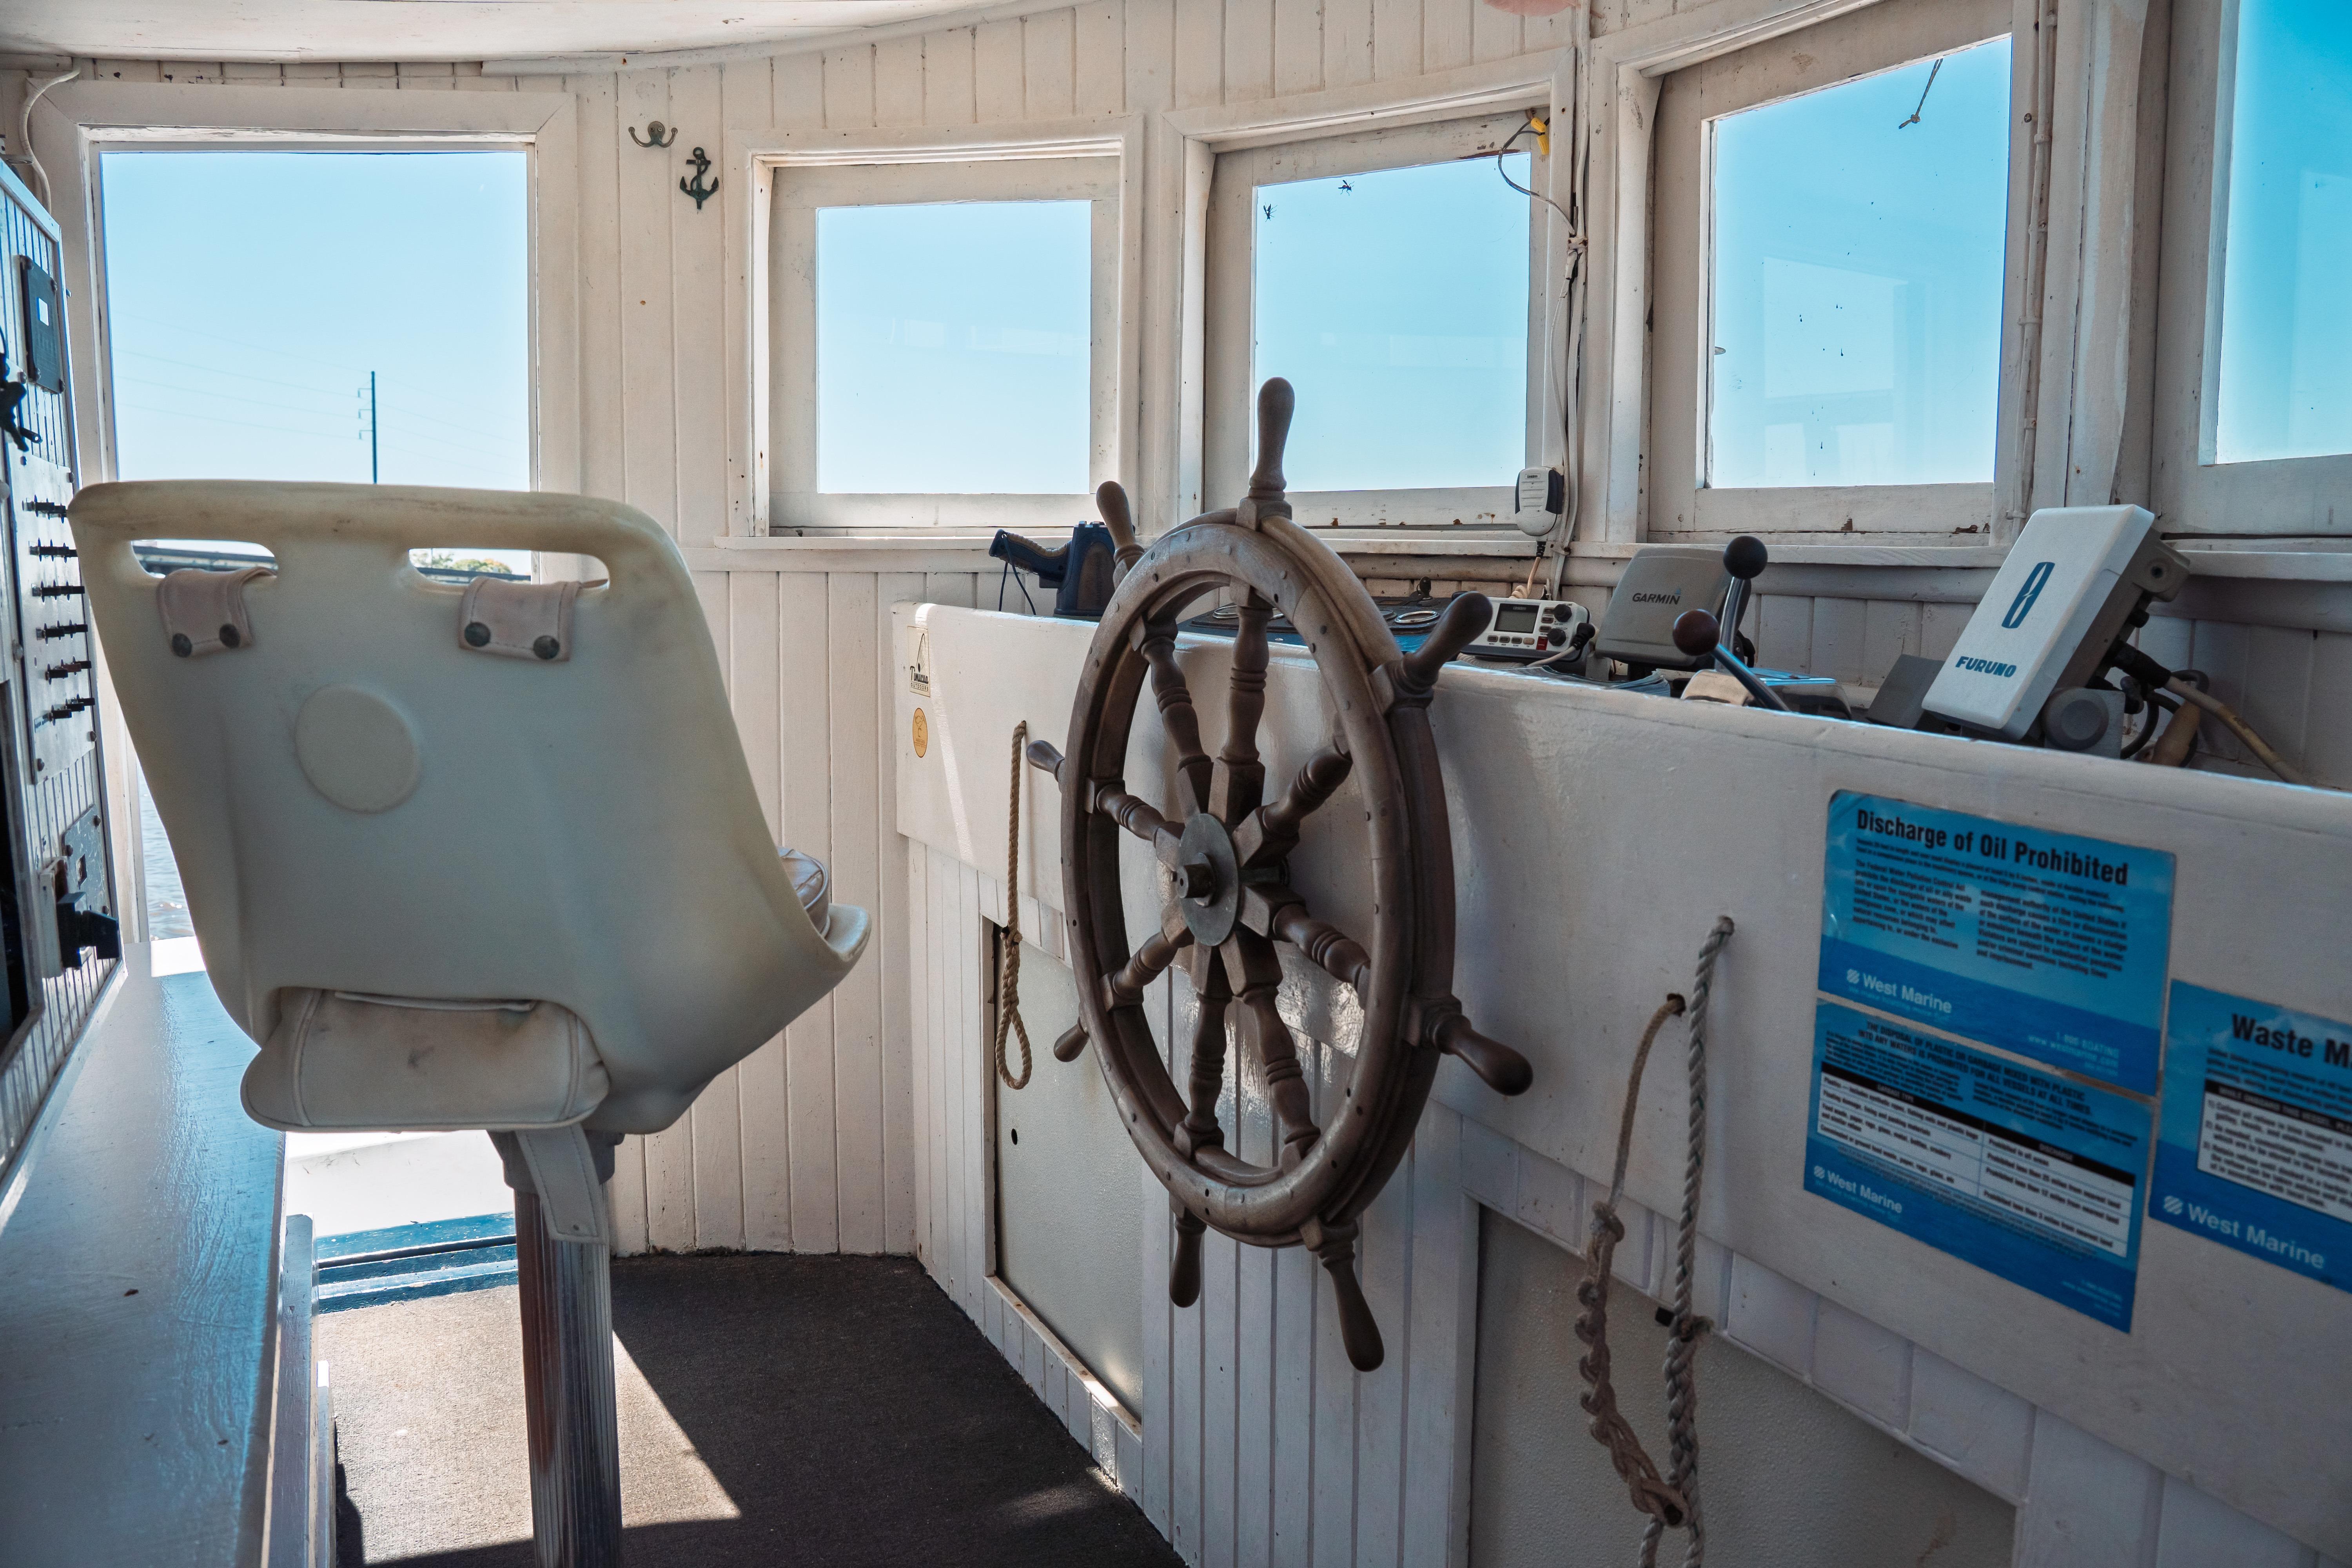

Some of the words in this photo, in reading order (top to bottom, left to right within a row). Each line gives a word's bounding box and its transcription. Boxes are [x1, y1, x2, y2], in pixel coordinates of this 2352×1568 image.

[1633, 592, 1681, 605] GARMIN
[910, 666, 929, 684] Timucua
[911, 682, 929, 691] OUTDOORS
[1956, 656, 2017, 678] FURUNO
[1857, 809, 1947, 847] Discharge
[1953, 828, 1973, 853] of
[1979, 834, 2007, 860] Oil
[2014, 840, 2129, 885] Prohibited
[1862, 973, 1897, 997] West
[1901, 985, 1951, 1014] Marine
[2231, 1012, 2313, 1059] Waste
[1925, 1040, 1954, 1058] PLASTIC
[2051, 1082, 2085, 1102] PLASTIC
[1827, 1170, 1857, 1194] West
[1859, 1184, 1902, 1215] Marine
[2187, 1203, 2240, 1239] West
[2246, 1224, 2324, 1271] Marine
